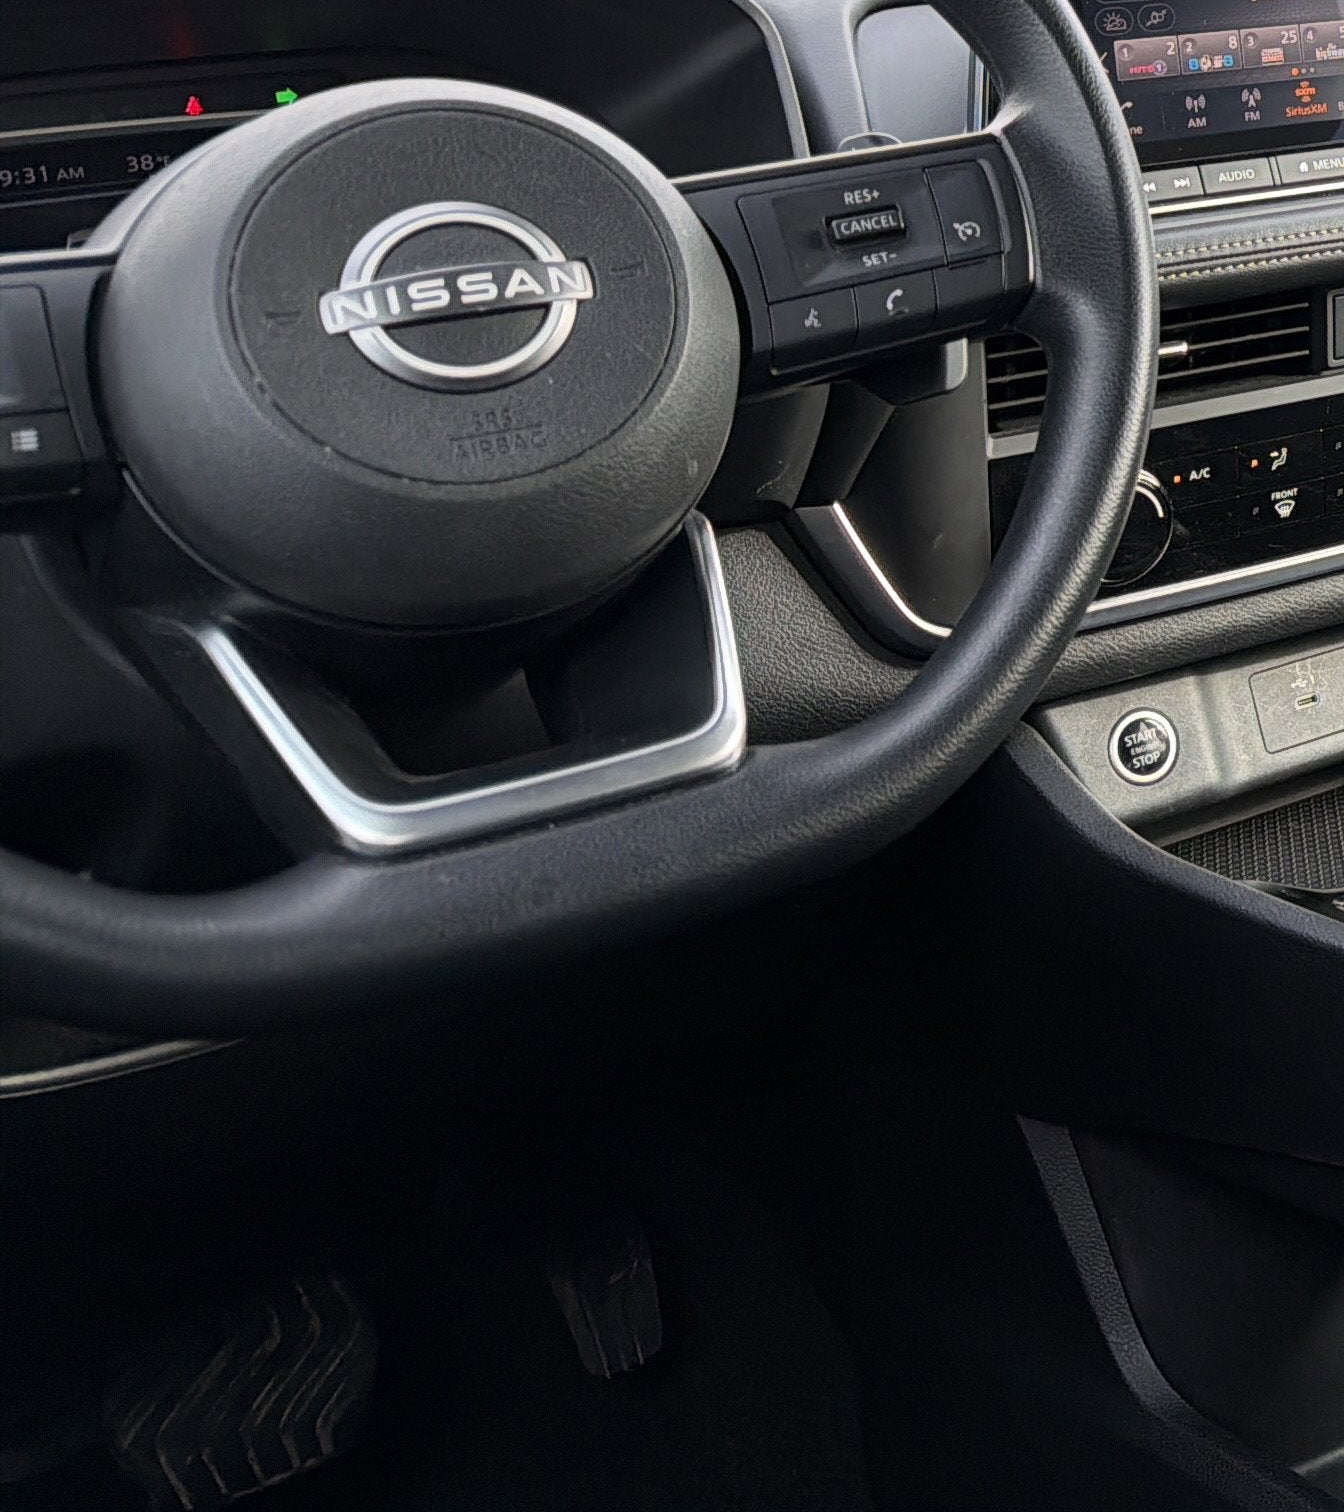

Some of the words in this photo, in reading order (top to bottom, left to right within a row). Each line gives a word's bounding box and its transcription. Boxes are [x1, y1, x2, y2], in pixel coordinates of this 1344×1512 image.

[1185, 42, 1193, 53] 2
[1228, 36, 1238, 50] 8
[1247, 35, 1255, 47] 3
[1280, 30, 1298, 45] 25
[1307, 30, 1314, 42] 4
[1122, 47, 1129, 59] 1
[1166, 41, 1176, 56] 2
[1244, 111, 1260, 122] FM
[1286, 103, 1328, 118] SiriusXM
[1188, 117, 1207, 128] AM
[0, 165, 48, 187] 9:31
[57, 167, 85, 181] AM
[1218, 168, 1255, 183] AUDIO
[844, 189, 880, 206] RES+
[840, 216, 897, 235] CANCEL
[331, 265, 587, 326] NISSAN
[1189, 467, 1211, 481] A/C
[1271, 488, 1299, 501] FRONT
[1124, 728, 1157, 748] START
[1132, 750, 1161, 769] STOP
